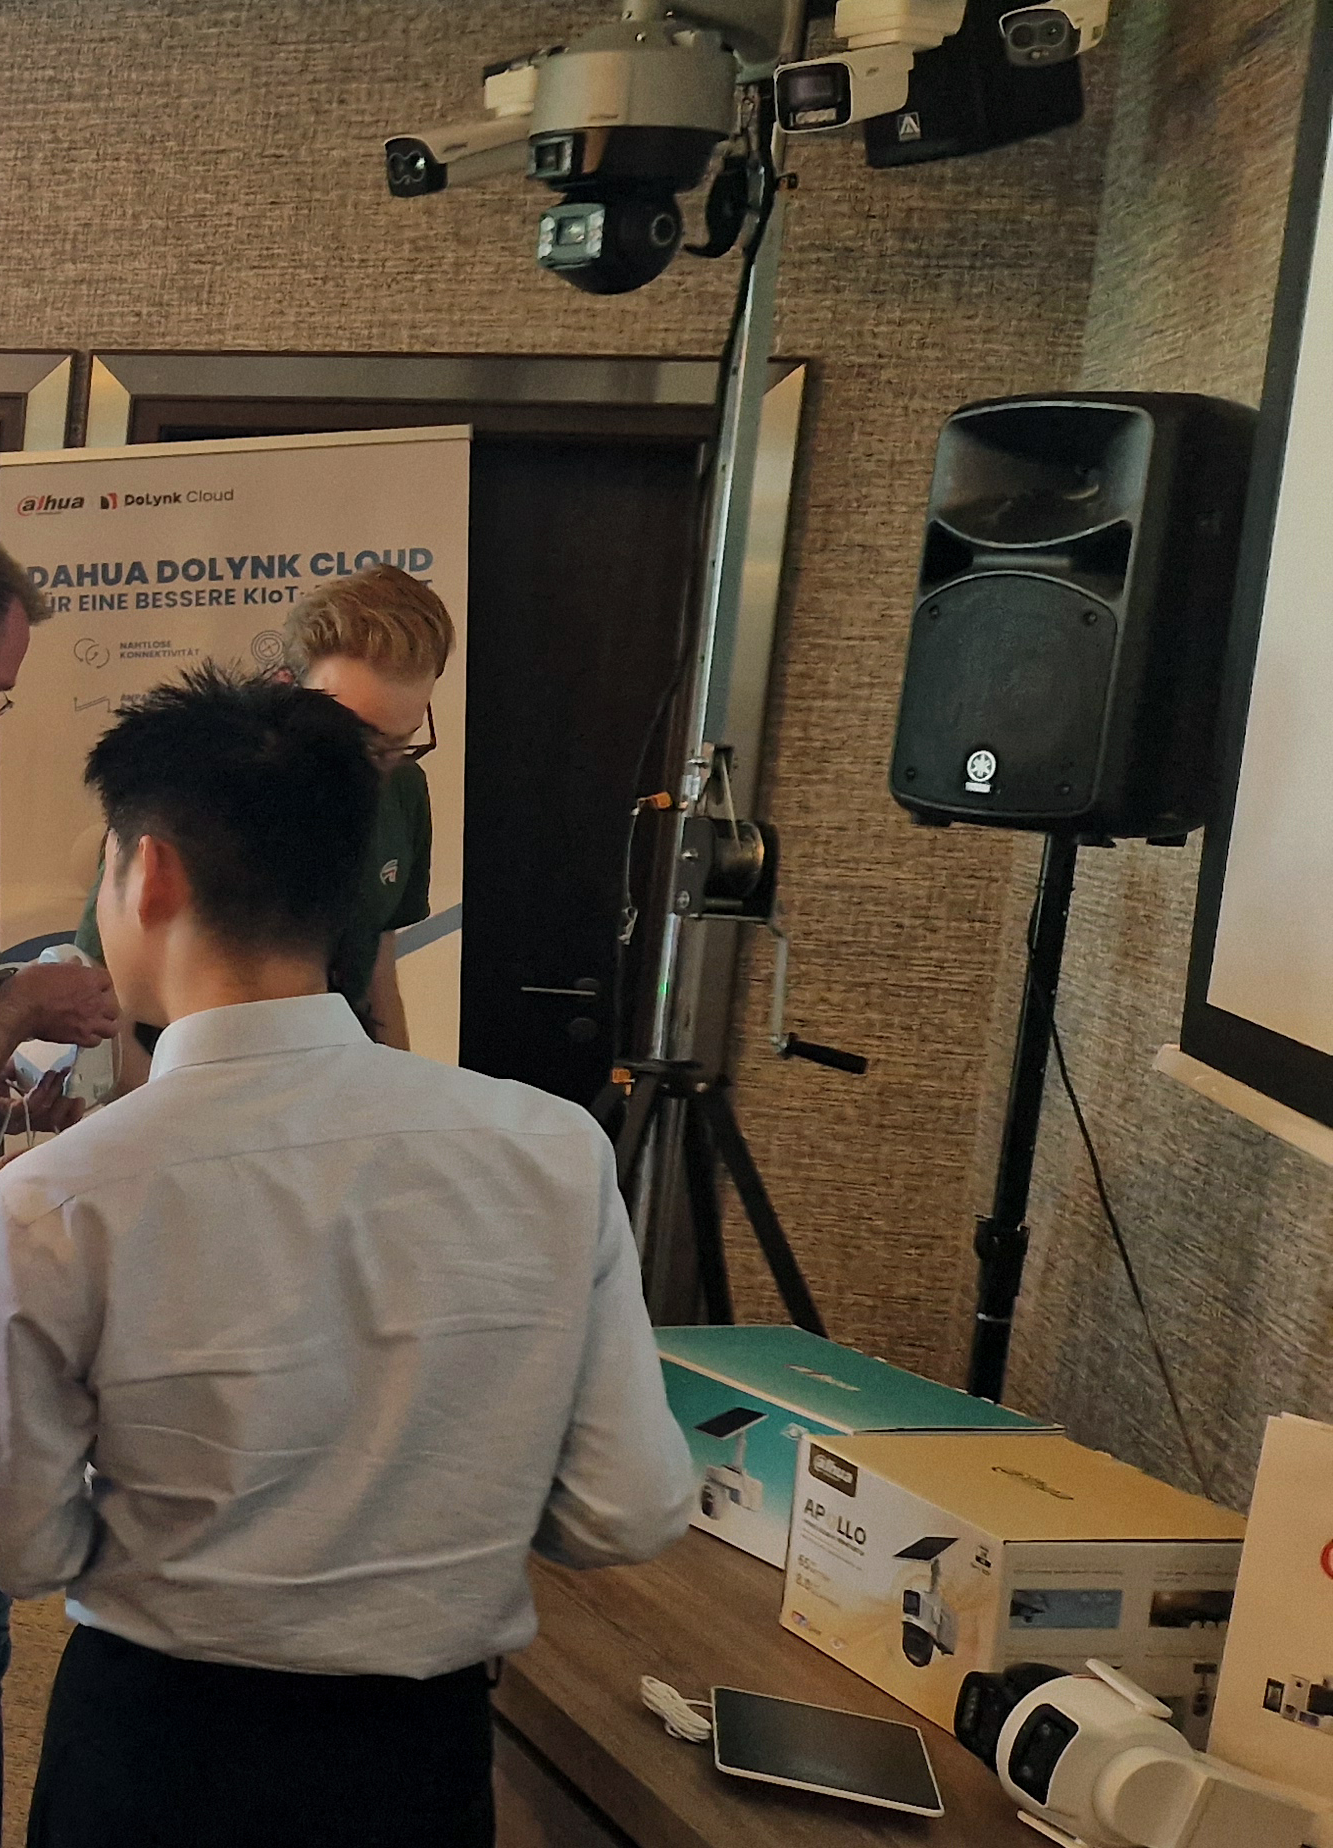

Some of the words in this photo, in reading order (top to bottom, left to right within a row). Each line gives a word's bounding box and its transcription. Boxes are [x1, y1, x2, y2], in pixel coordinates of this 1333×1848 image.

[124, 492, 181, 507] DoLynk
[186, 488, 234, 504] Cloud
[26, 559, 150, 590] DAHUA
[156, 552, 302, 584] DOLYNK
[309, 546, 434, 578] CLOUD
[78, 592, 129, 613] EINE
[134, 587, 237, 610] BESSERE
[119, 639, 172, 650] NAHTLOSE
[119, 647, 200, 660] KONNEKTIVITÄT
